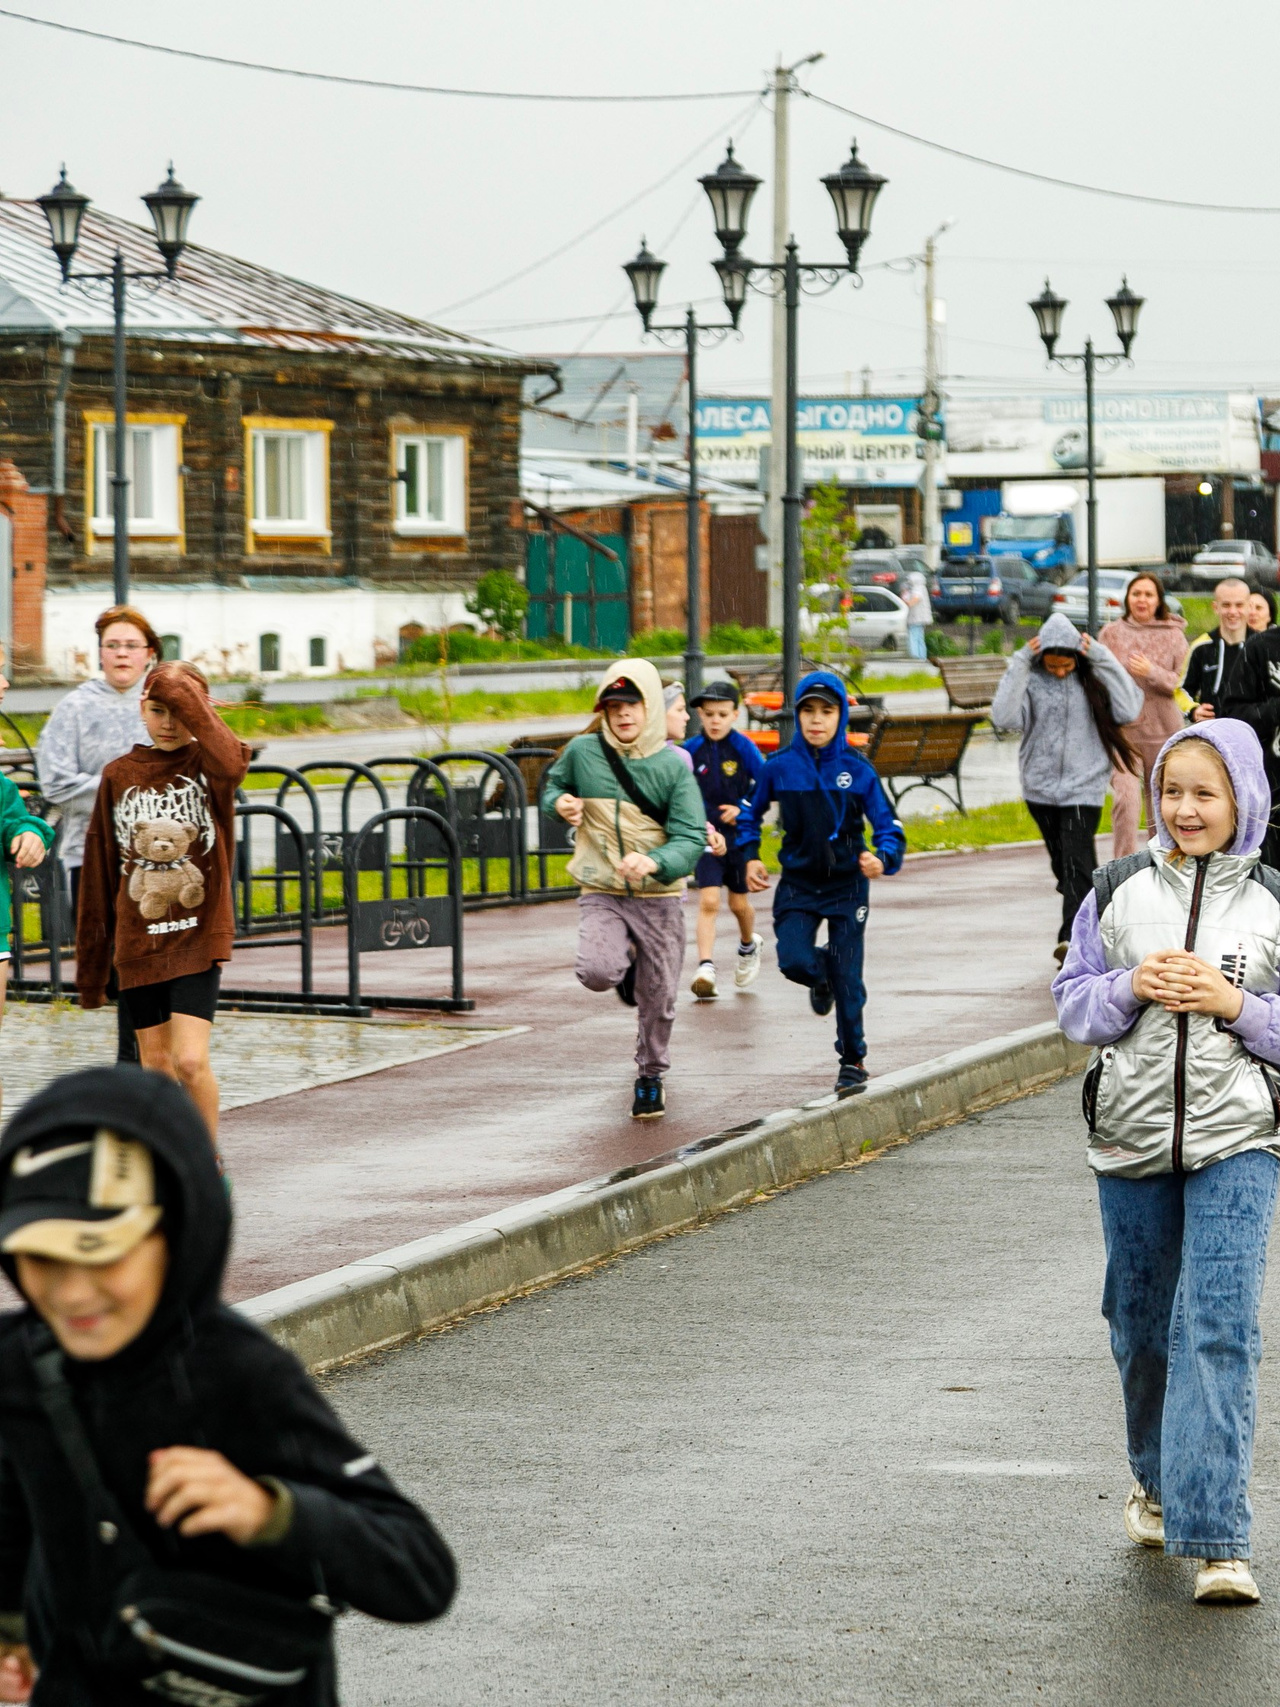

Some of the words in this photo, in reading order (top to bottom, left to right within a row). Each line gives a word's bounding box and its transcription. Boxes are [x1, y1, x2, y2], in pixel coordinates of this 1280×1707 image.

[694, 405, 771, 430] ЛЕСА
[795, 403, 904, 431] ЫГОДНО
[851, 442, 910, 463] ЦЕНТР
